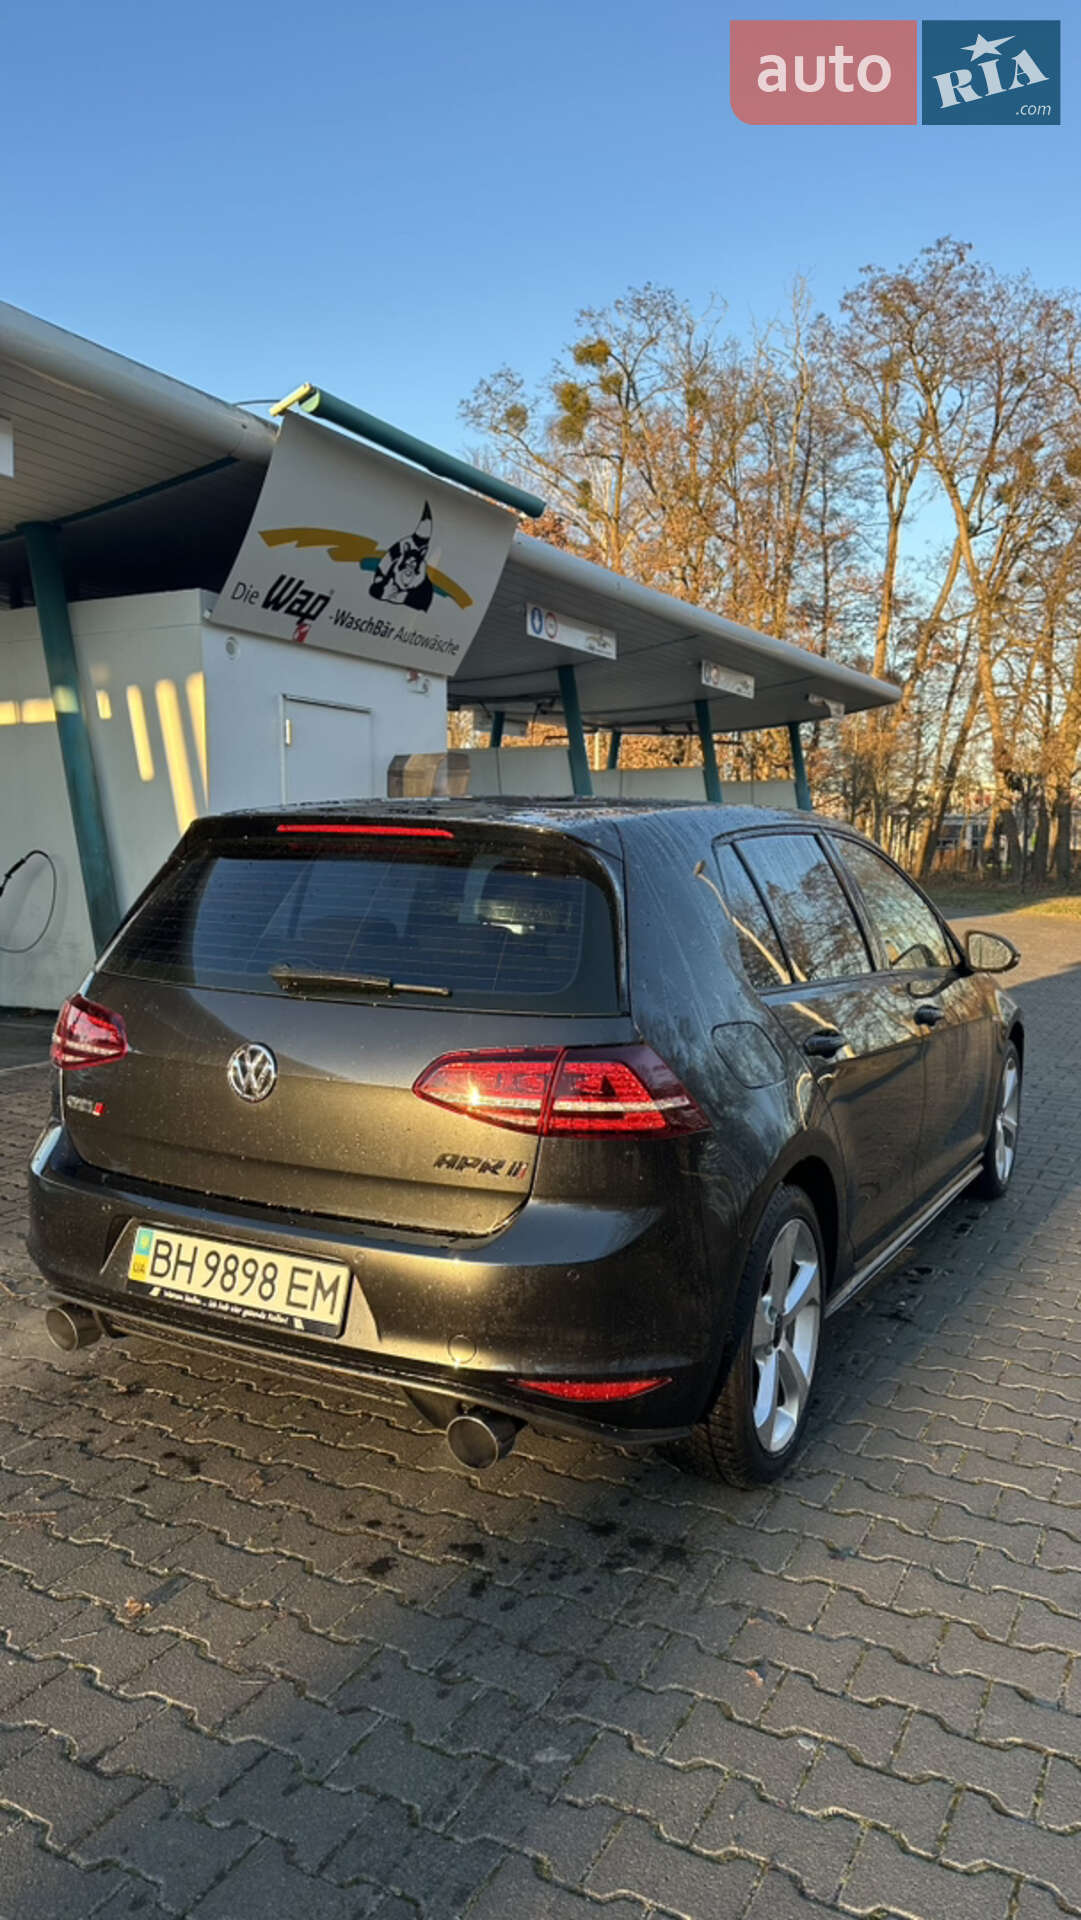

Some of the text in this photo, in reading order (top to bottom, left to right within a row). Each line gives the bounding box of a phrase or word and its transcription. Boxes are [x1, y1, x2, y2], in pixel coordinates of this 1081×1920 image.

[231, 582, 260, 605] Die
[262, 574, 331, 626] Wap
[393, 626, 459, 656] Autowäsche
[150, 1239, 198, 1285] BH
[202, 1250, 278, 1302] 9898
[286, 1266, 341, 1315] EM
